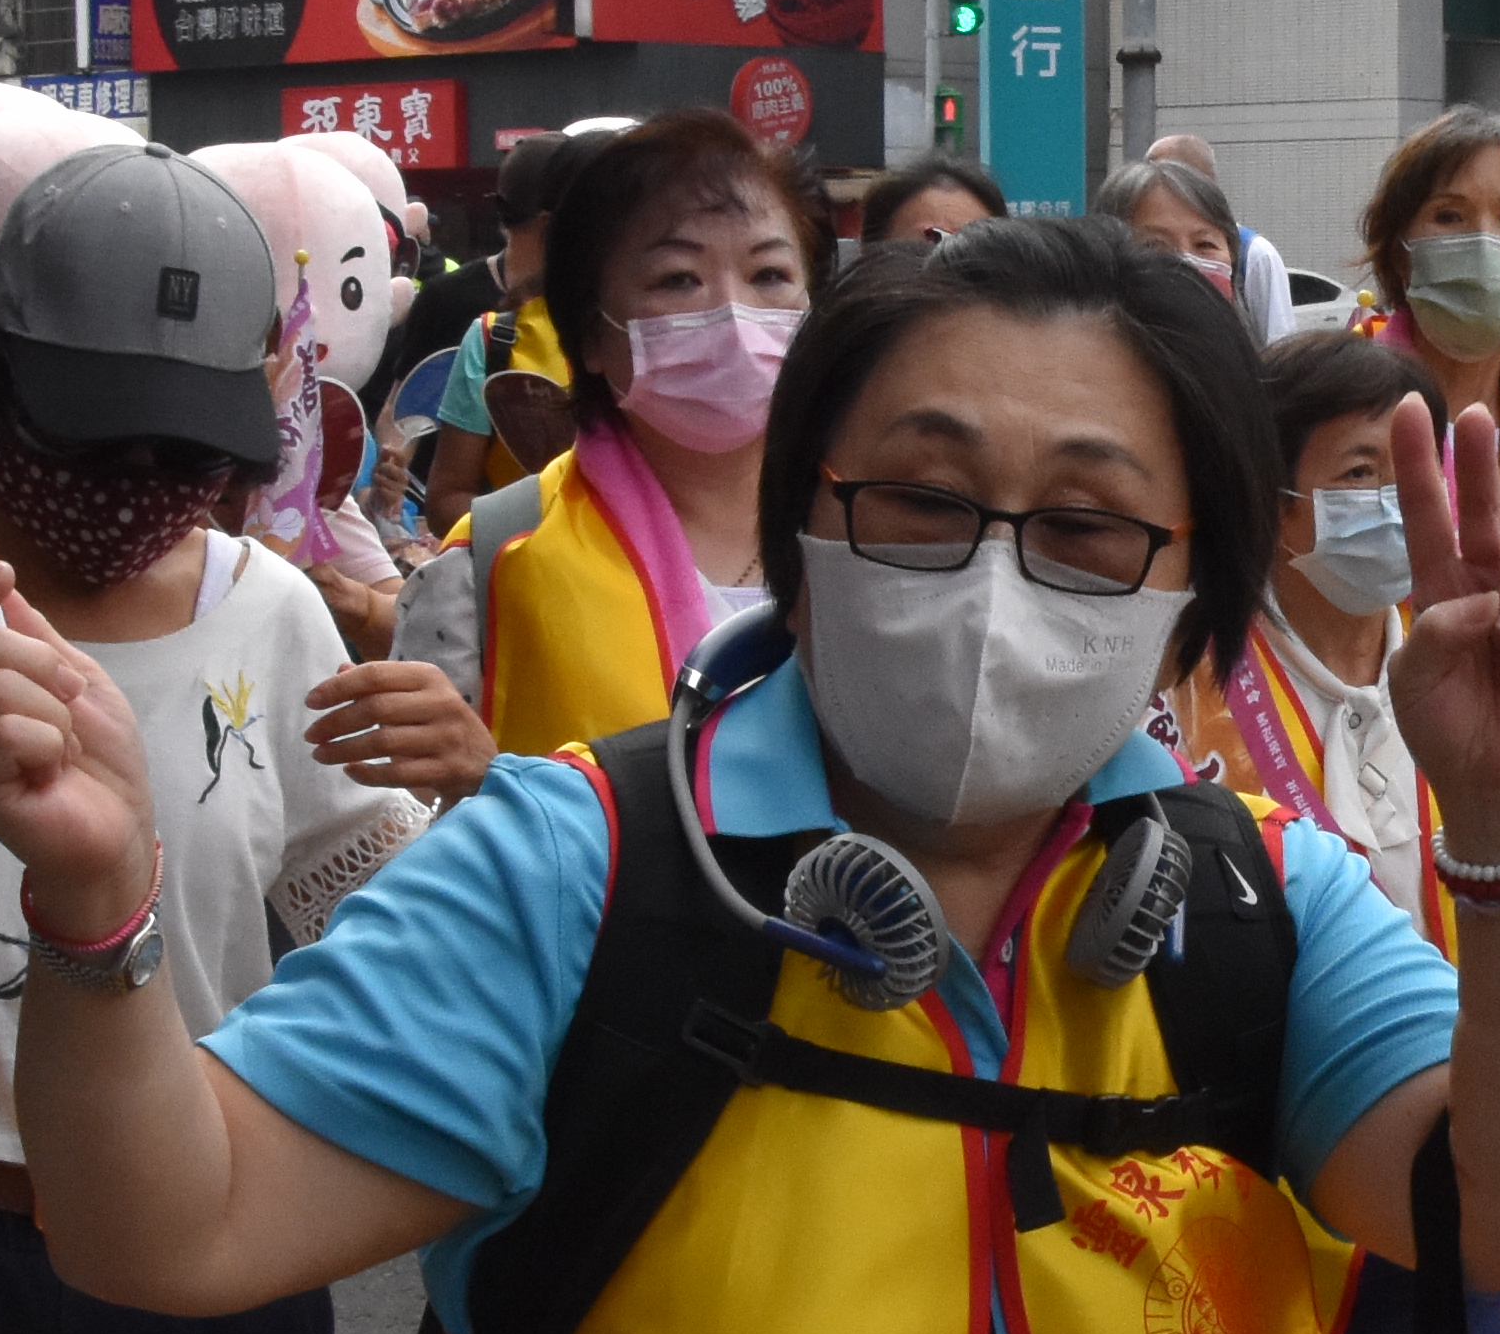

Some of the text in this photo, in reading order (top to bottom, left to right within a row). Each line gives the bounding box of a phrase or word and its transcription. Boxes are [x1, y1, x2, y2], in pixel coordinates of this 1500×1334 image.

[28, 75, 149, 118] 明汽車修理廠
[754, 75, 798, 99] 100%
[1045, 657, 1085, 673] Made
